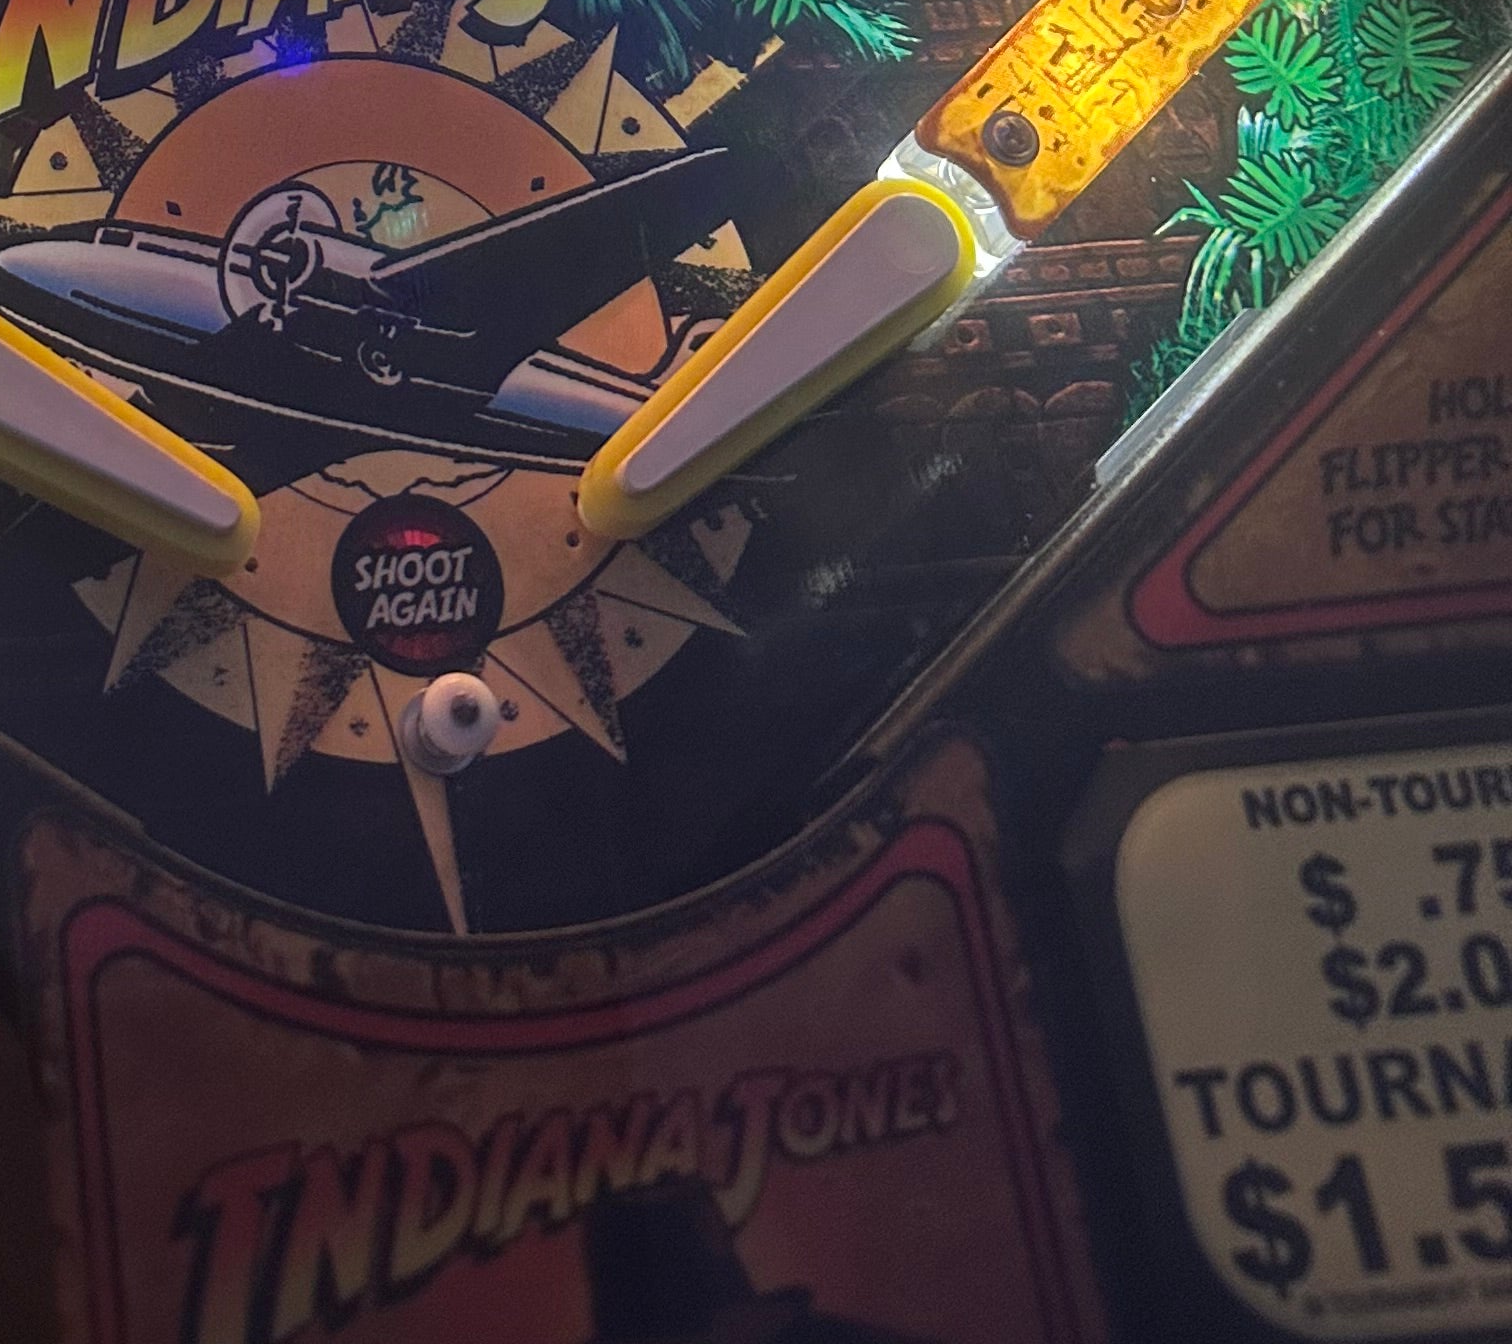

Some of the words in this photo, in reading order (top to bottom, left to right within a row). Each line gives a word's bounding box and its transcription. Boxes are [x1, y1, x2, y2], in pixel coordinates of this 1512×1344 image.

[1327, 500, 1426, 557] FOR
[354, 546, 473, 592] SHOOT
[366, 587, 479, 629] AGAIN
[1242, 766, 1512, 832] NON-TOUR
[1298, 850, 1358, 937] $
[1175, 1039, 1512, 1141] TOURN
[173, 1087, 716, 1344] INDIANA
[692, 1045, 964, 1233] JONES
